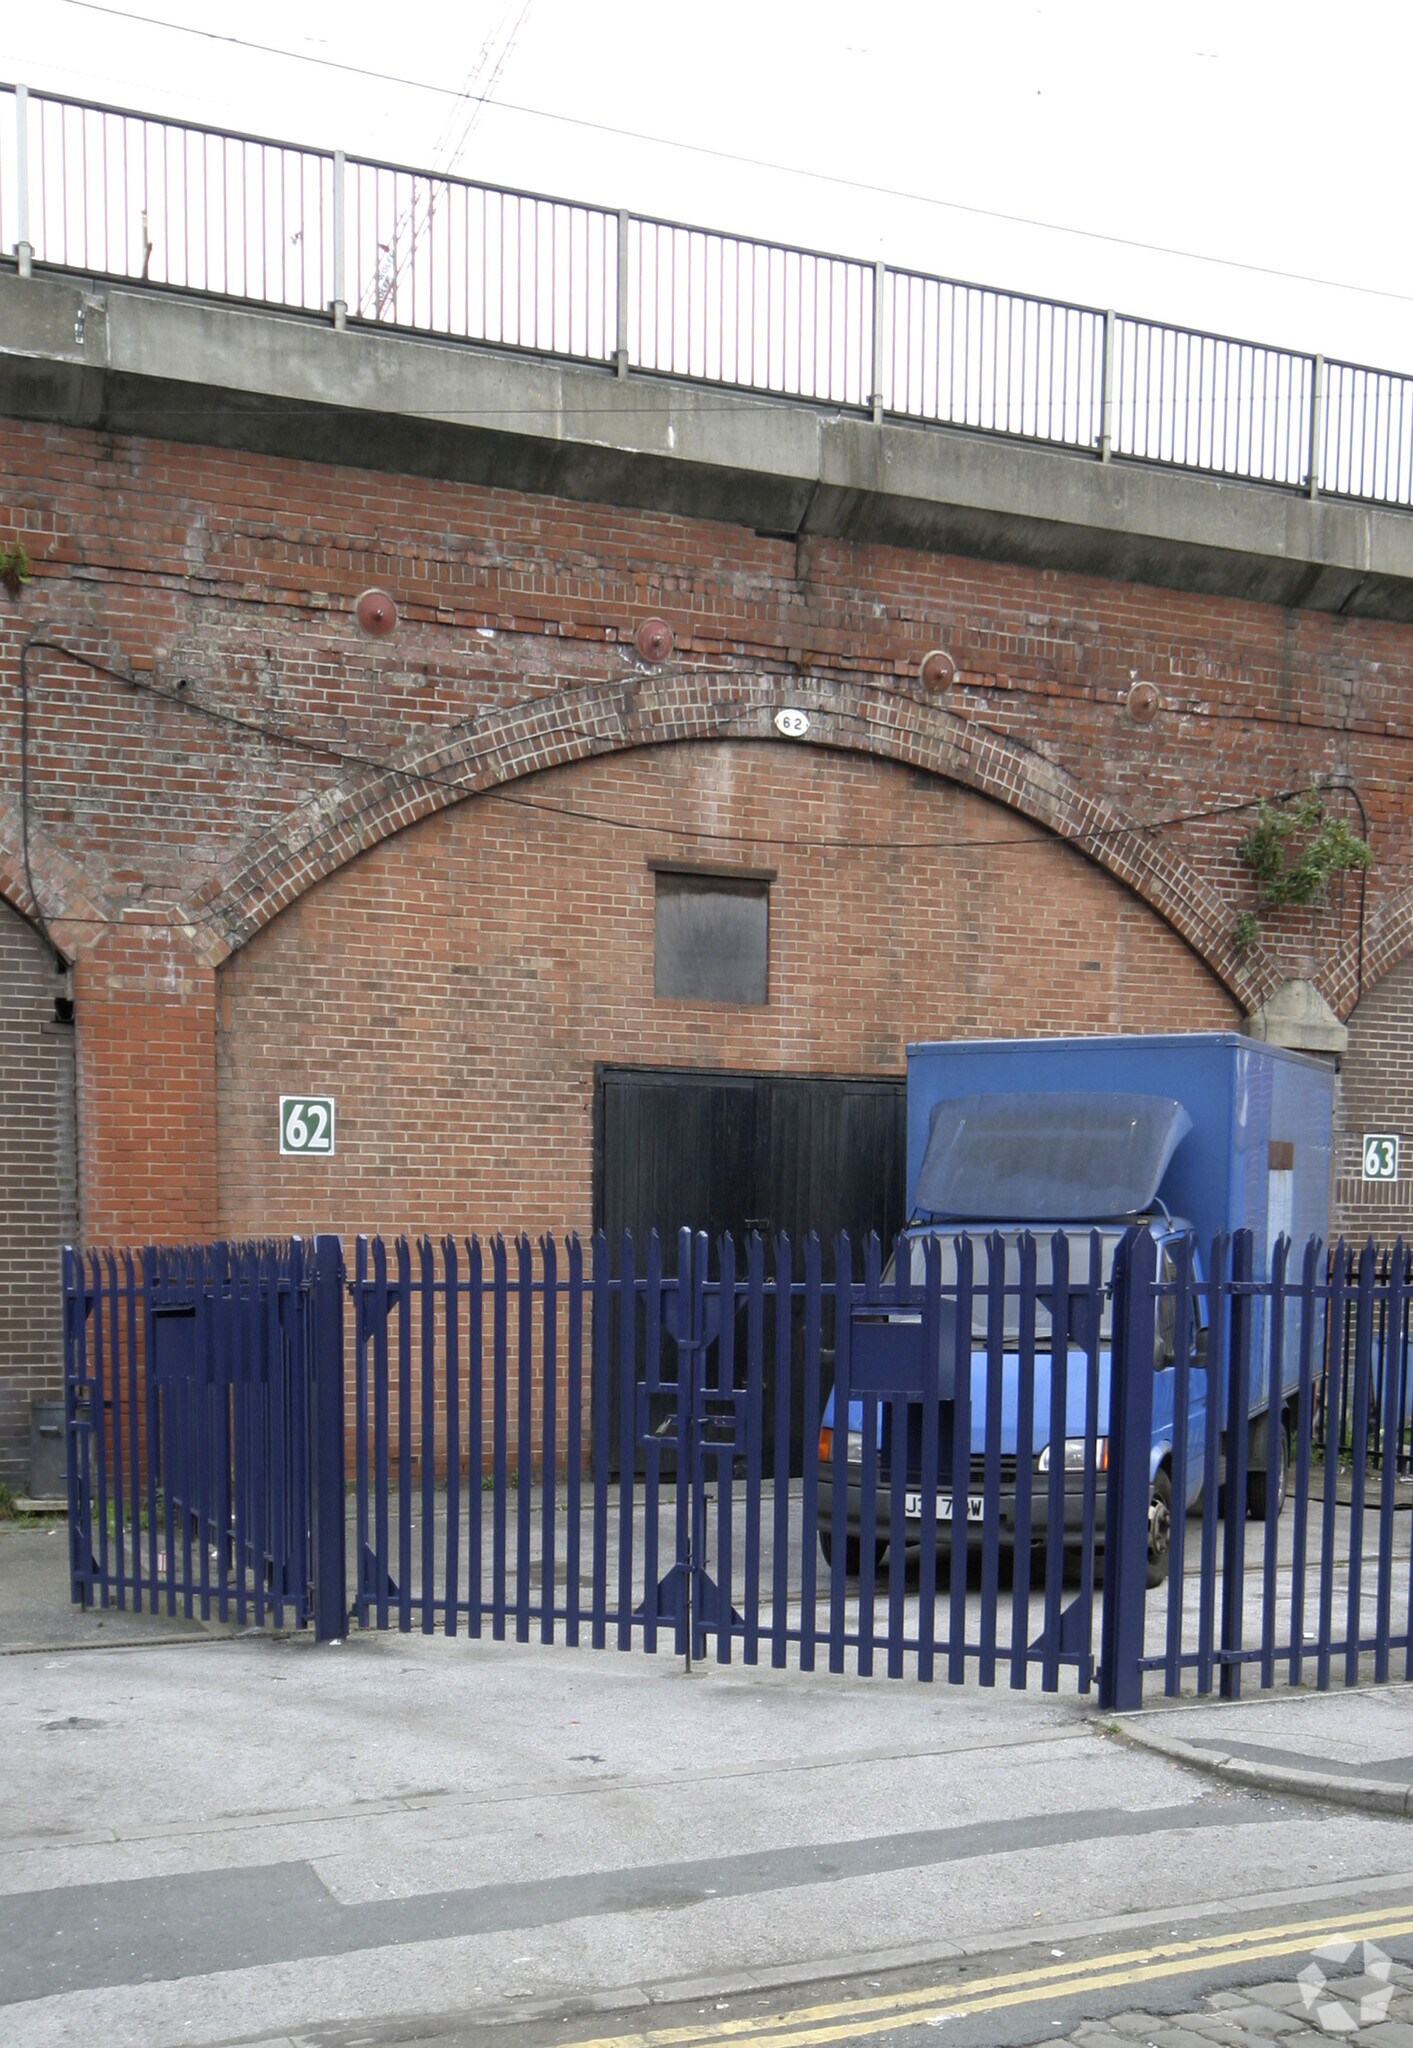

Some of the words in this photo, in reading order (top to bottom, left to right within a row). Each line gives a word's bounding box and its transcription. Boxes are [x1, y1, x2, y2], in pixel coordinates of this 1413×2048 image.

[783, 716, 802, 730] 62
[286, 1104, 329, 1148] 62
[1365, 1141, 1394, 1176] 63
